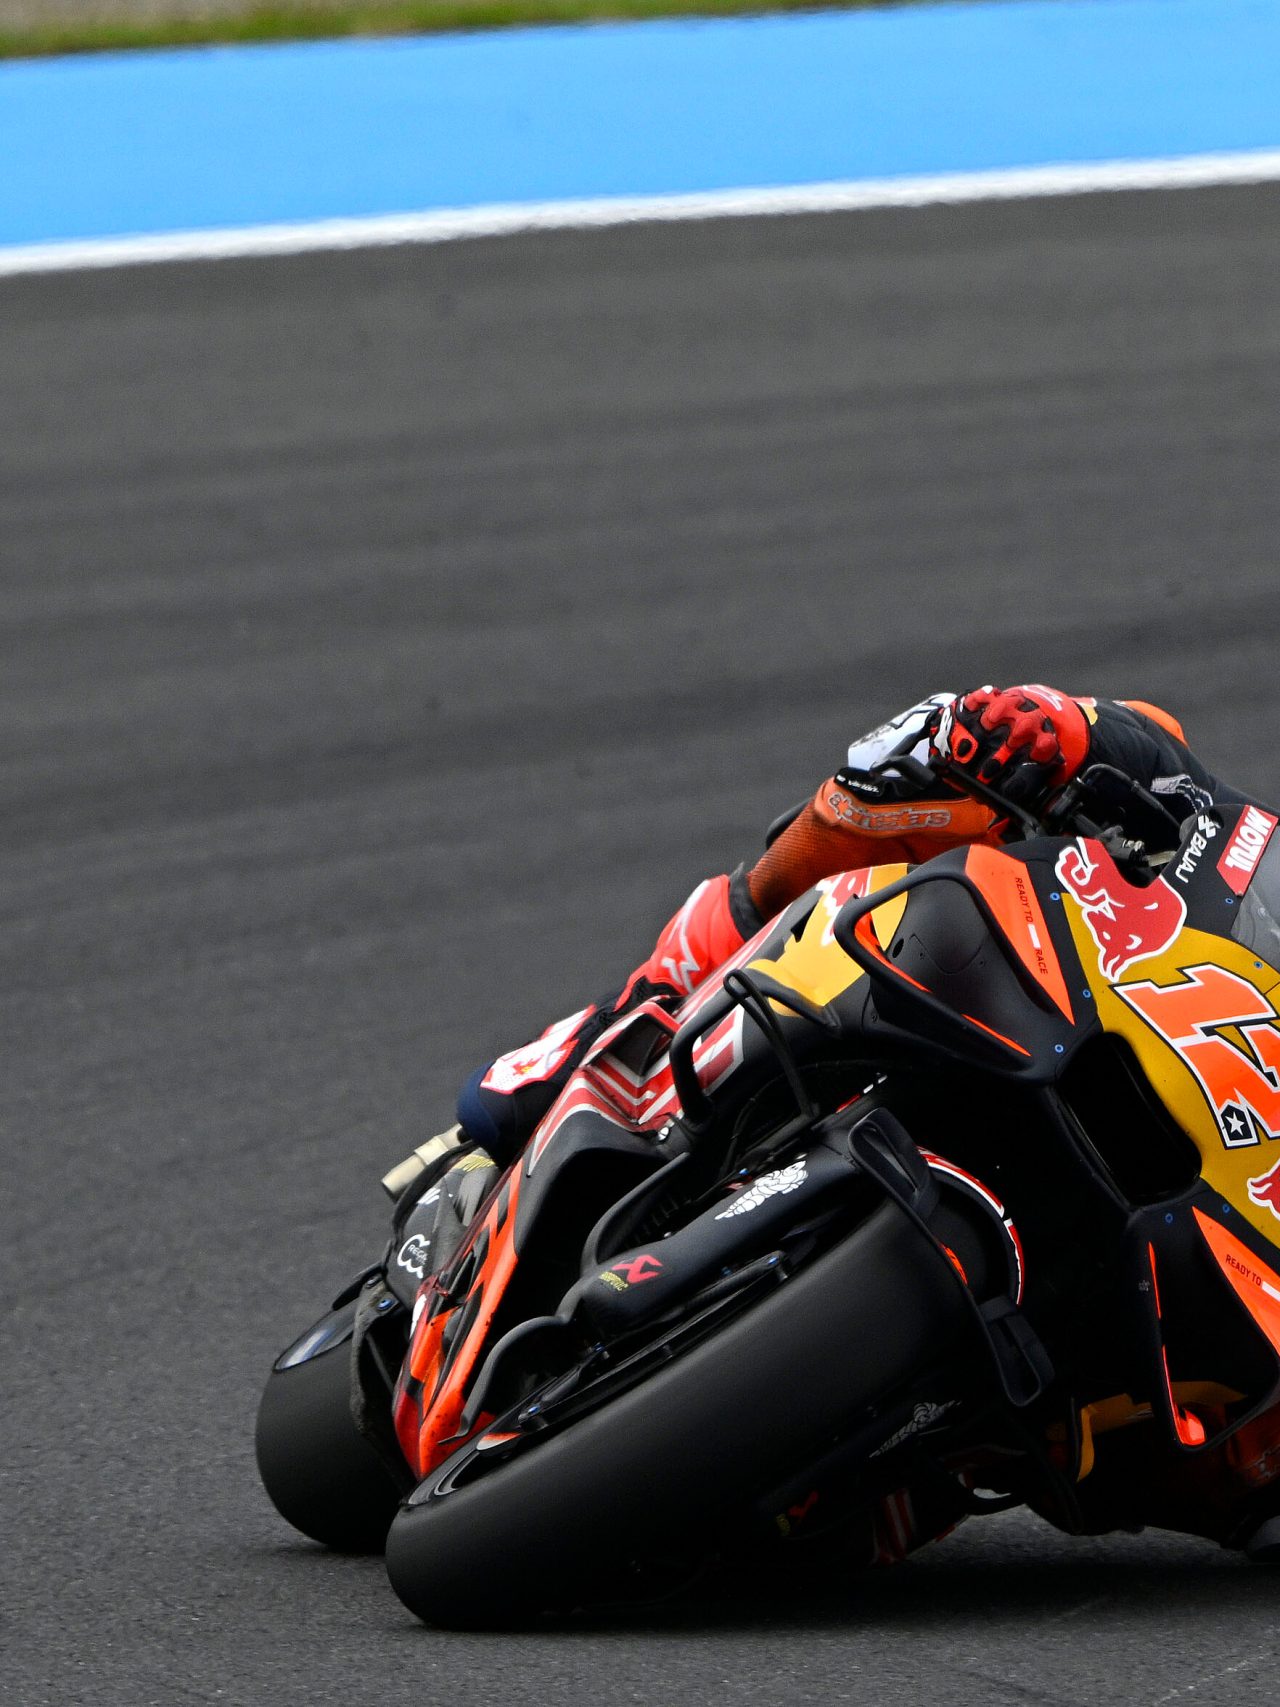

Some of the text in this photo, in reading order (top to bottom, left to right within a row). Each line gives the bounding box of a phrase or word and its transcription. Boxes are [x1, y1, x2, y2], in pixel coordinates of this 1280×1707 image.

[1175, 832, 1208, 884] BAJAJ
[1224, 806, 1275, 872] MOTUL
[1015, 877, 1033, 923] READY TO
[1034, 949, 1048, 975] RACE
[1225, 1255, 1262, 1286] READY TO
